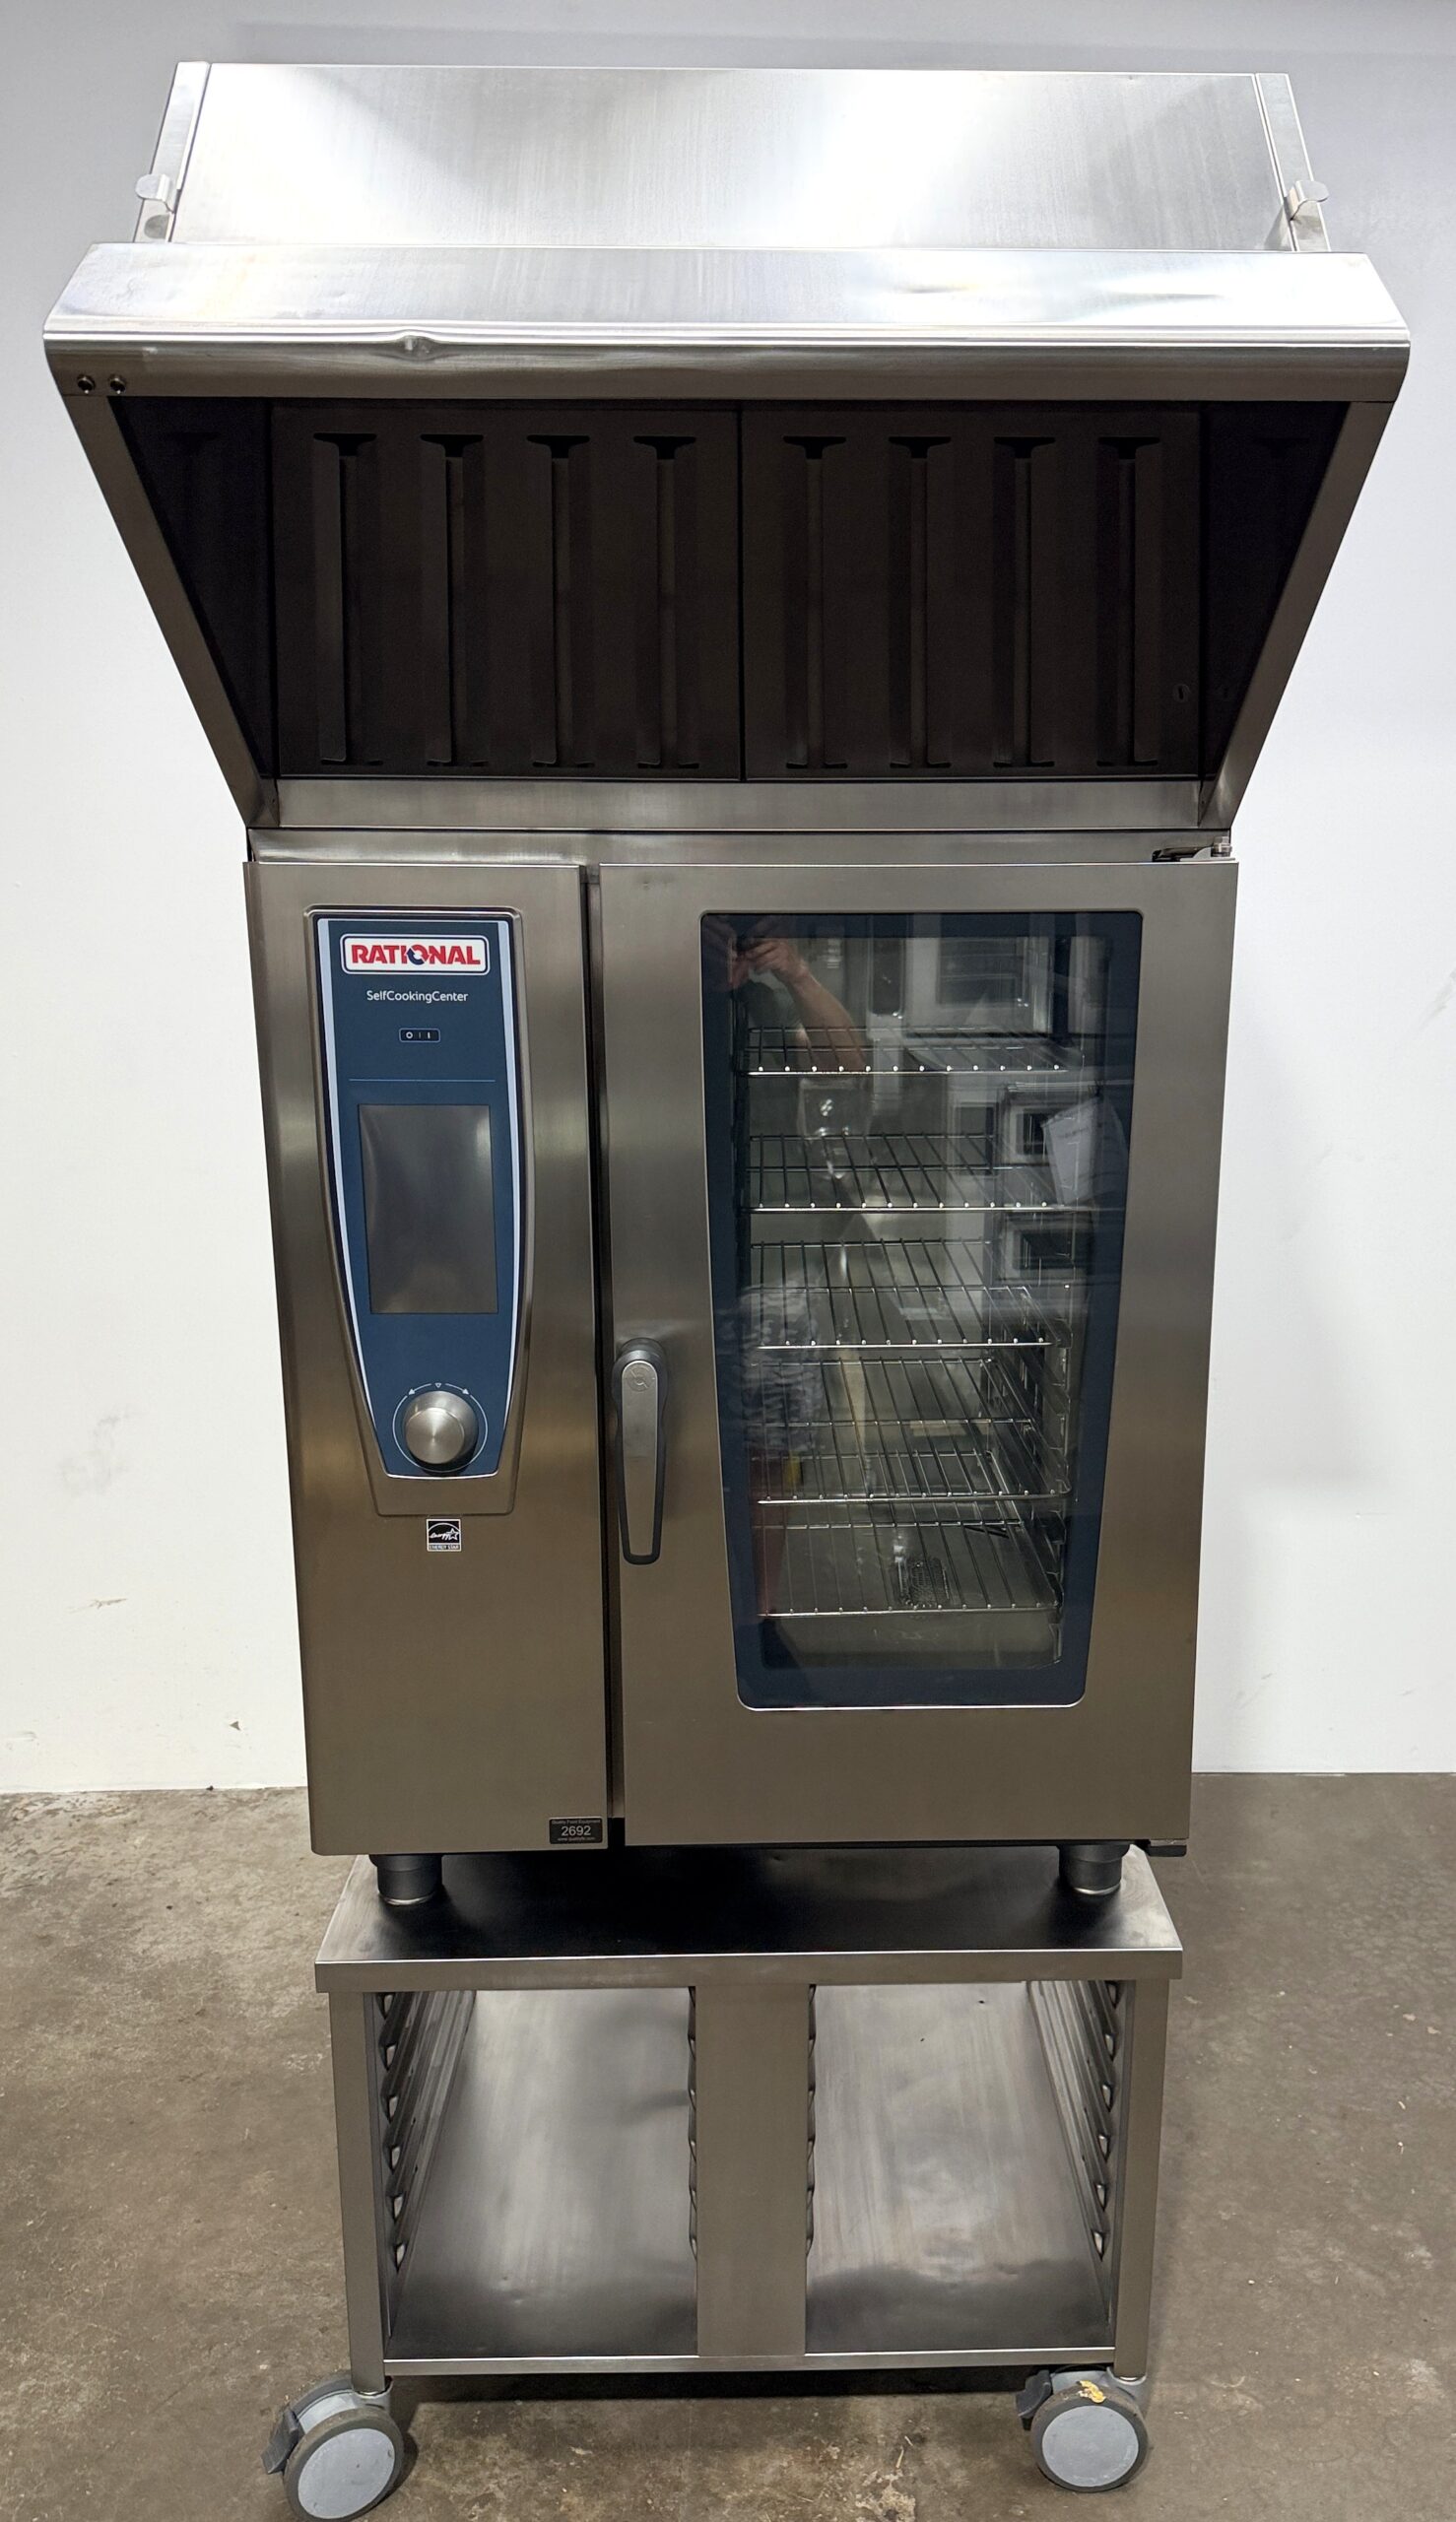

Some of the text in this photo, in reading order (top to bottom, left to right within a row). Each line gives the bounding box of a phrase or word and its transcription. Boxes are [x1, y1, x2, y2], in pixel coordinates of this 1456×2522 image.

[351, 944, 481, 965] RATIONAL
[366, 990, 469, 1004] SelfCookingCenter
[561, 1825, 591, 1836] 2692
